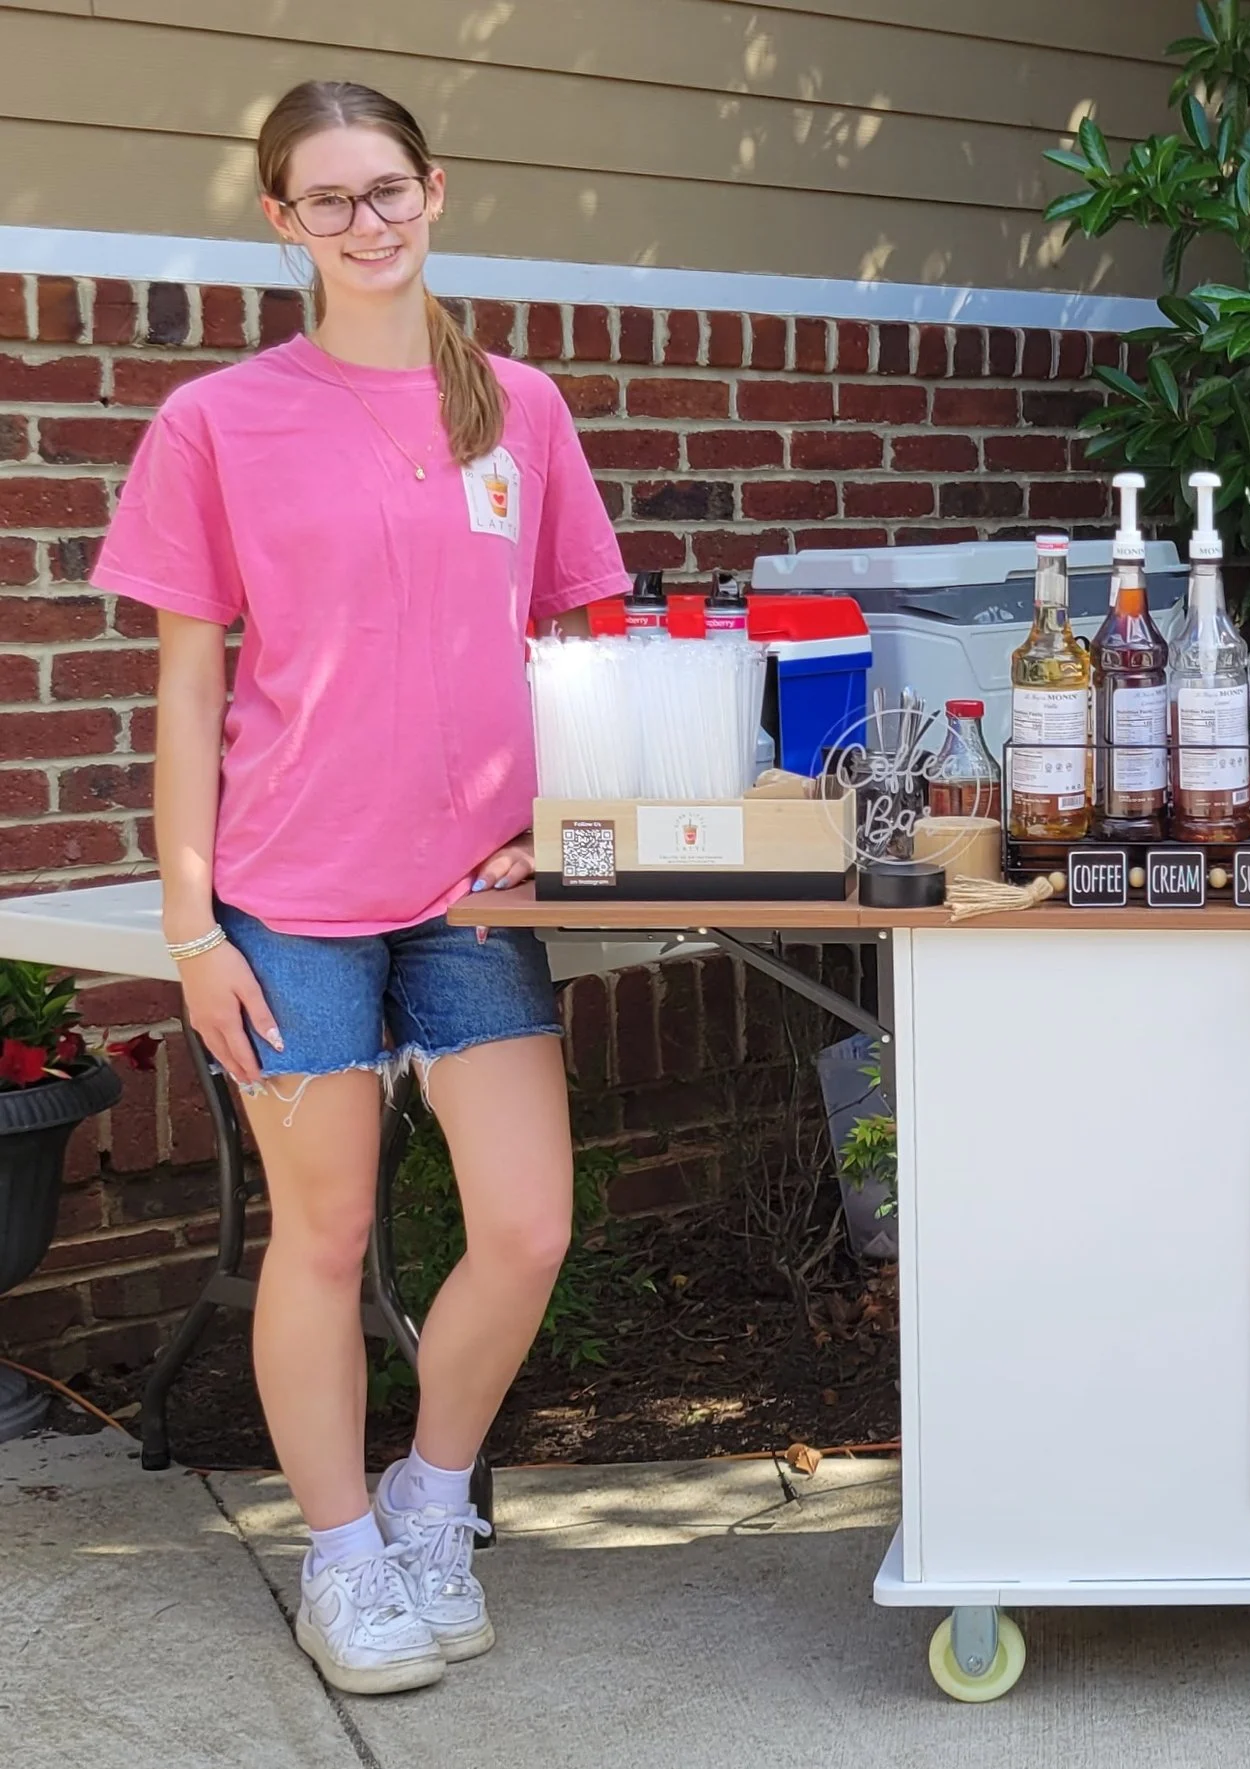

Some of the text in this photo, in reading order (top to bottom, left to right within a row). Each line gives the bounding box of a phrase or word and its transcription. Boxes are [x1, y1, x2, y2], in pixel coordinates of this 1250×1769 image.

[836, 742, 961, 794] Coffee
[865, 795, 938, 843] Bar
[1073, 865, 1122, 893] COFFEE
[1152, 865, 1200, 893] CREAM
